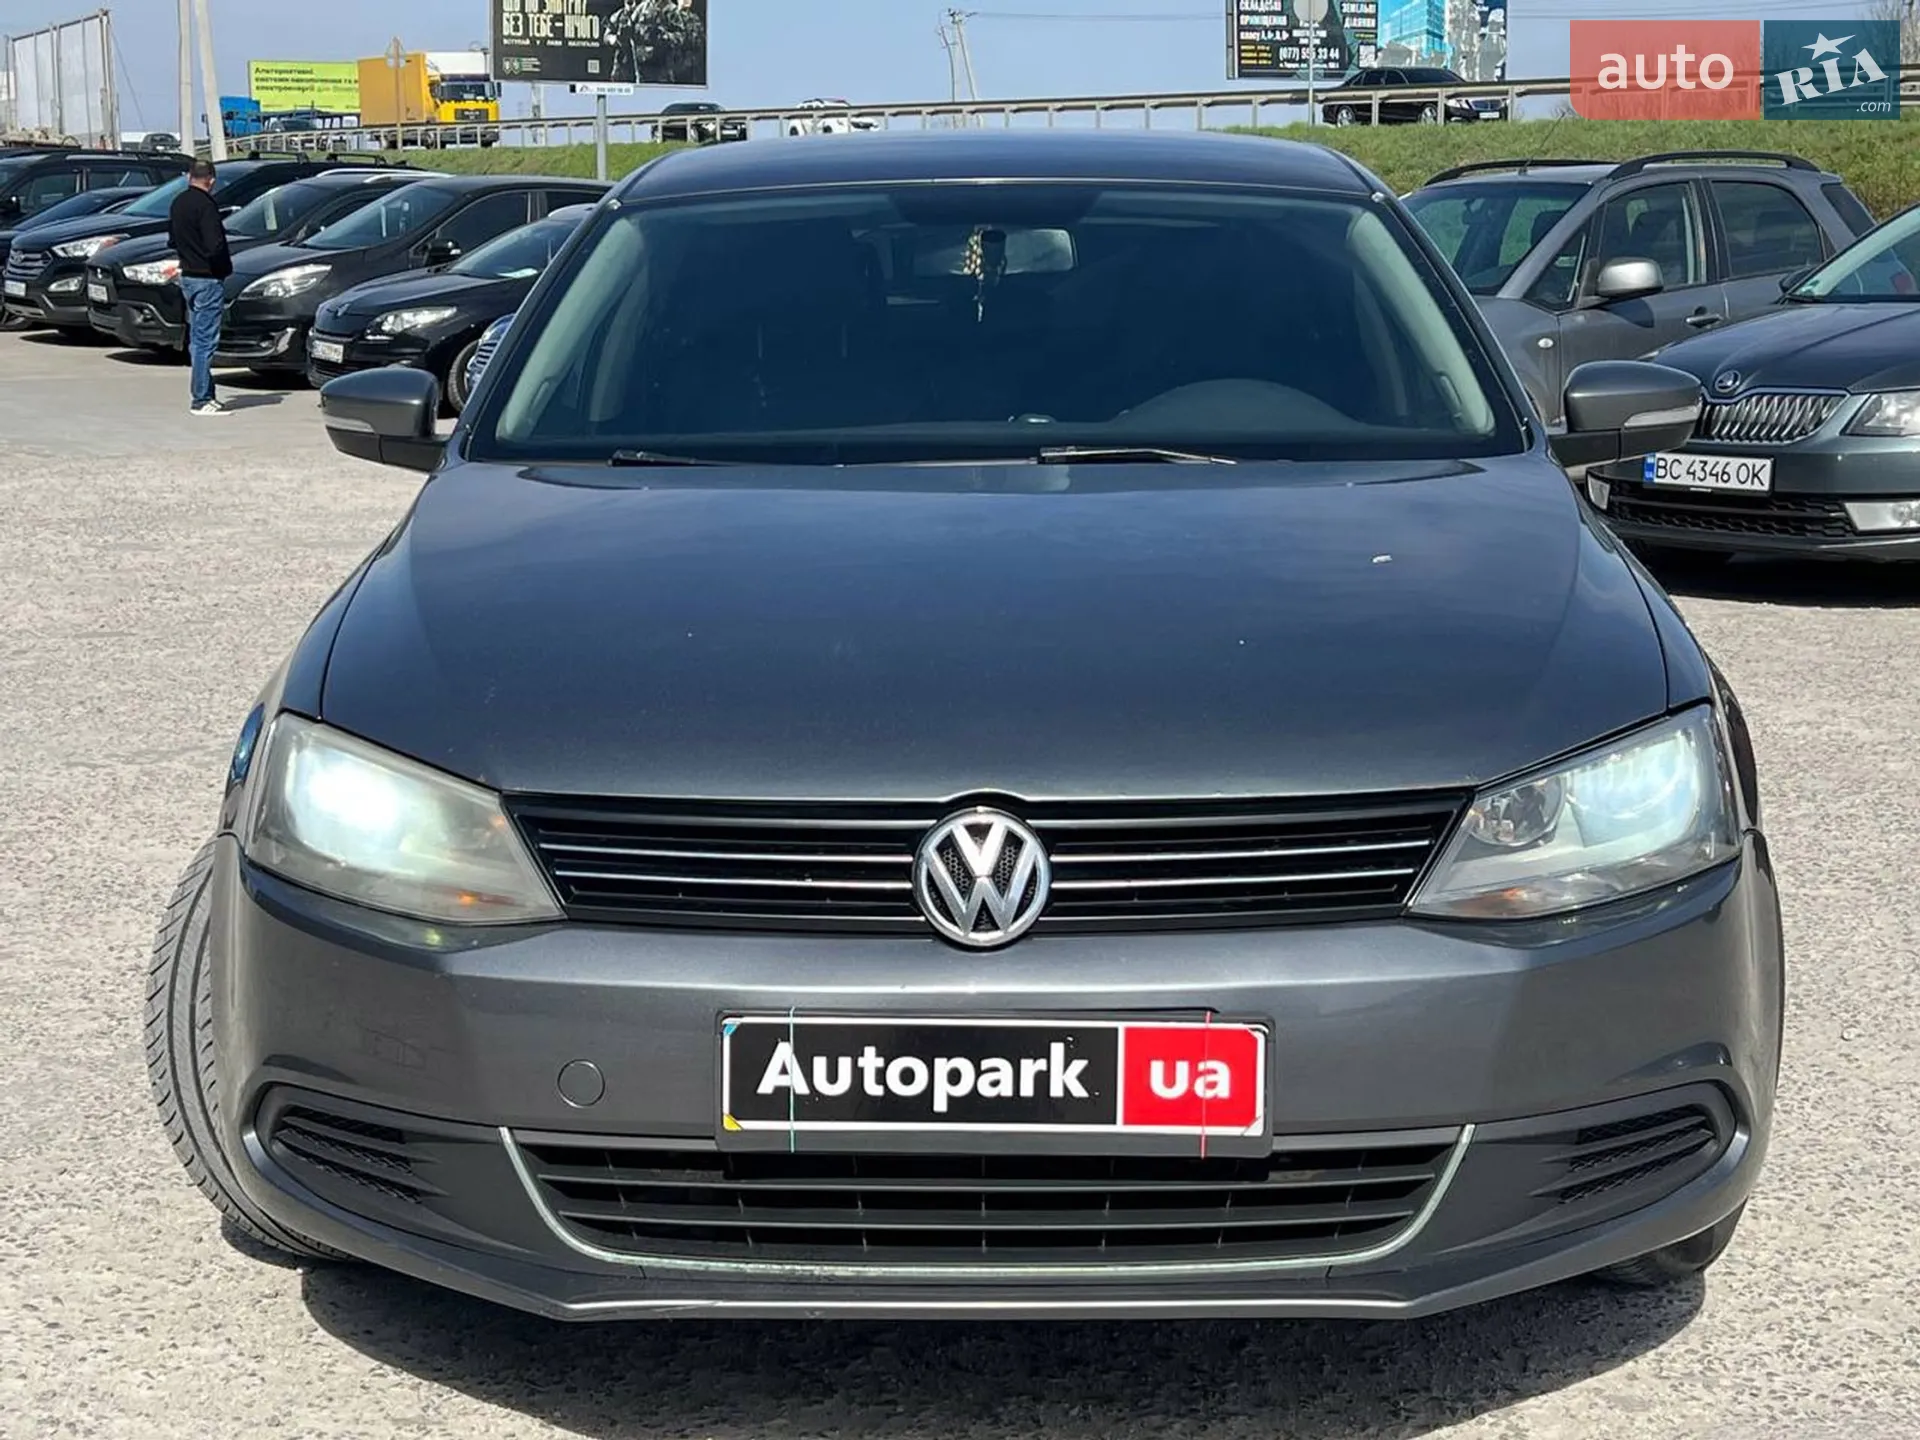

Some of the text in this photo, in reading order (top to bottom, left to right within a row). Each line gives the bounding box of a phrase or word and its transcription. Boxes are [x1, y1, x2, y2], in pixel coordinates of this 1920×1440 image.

[502, 12, 523, 36] БЕЗ
[528, 13, 554, 37] ТЕБЕ
[1656, 457, 1767, 486] BC 4346 OK
[757, 1041, 1232, 1113] Autopark ua
